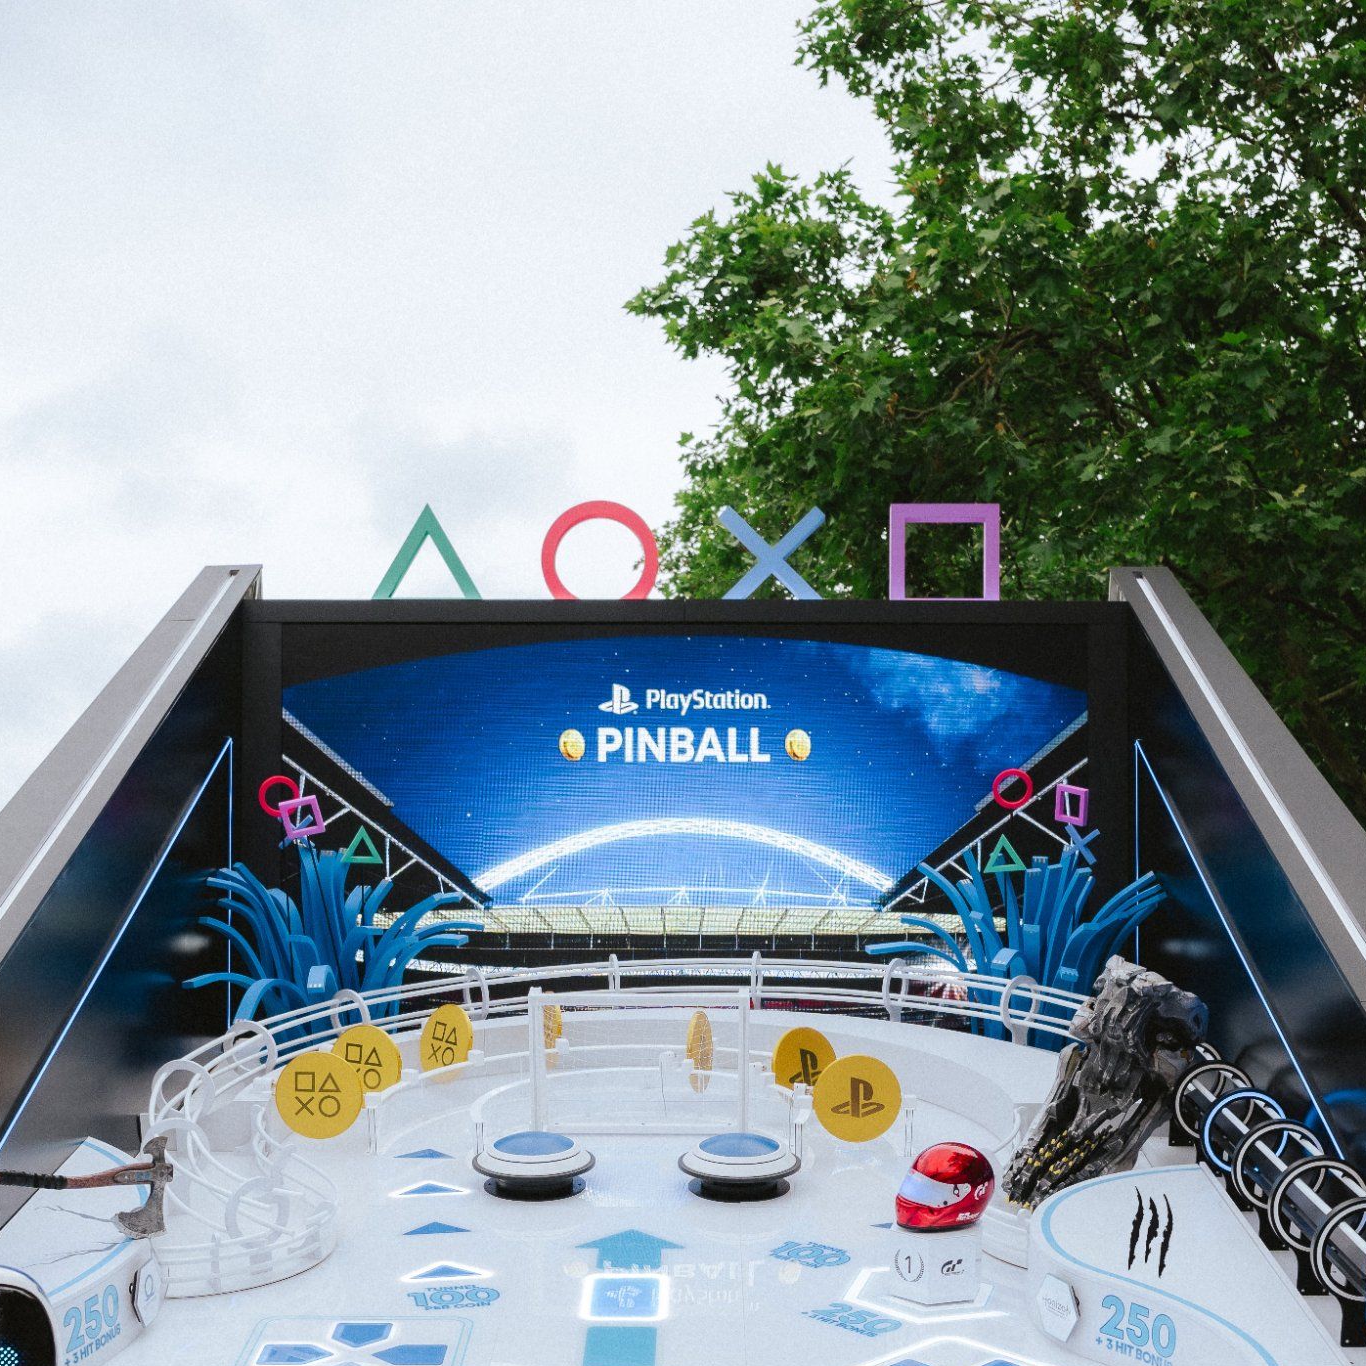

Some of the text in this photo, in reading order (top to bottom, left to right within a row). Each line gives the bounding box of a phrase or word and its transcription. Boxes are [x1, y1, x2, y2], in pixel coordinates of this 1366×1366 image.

[645, 688, 772, 716] PlayStation
[596, 727, 771, 763] PINBALL
[407, 1288, 500, 1306] 100
[63, 1284, 119, 1353] 250
[810, 1302, 902, 1333] 250
[1099, 1294, 1176, 1358] 250
[80, 1342, 94, 1360] HIT
[95, 1323, 121, 1351] BONUS
[1106, 1338, 1113, 1350] 3
[1115, 1340, 1135, 1358] HIT
